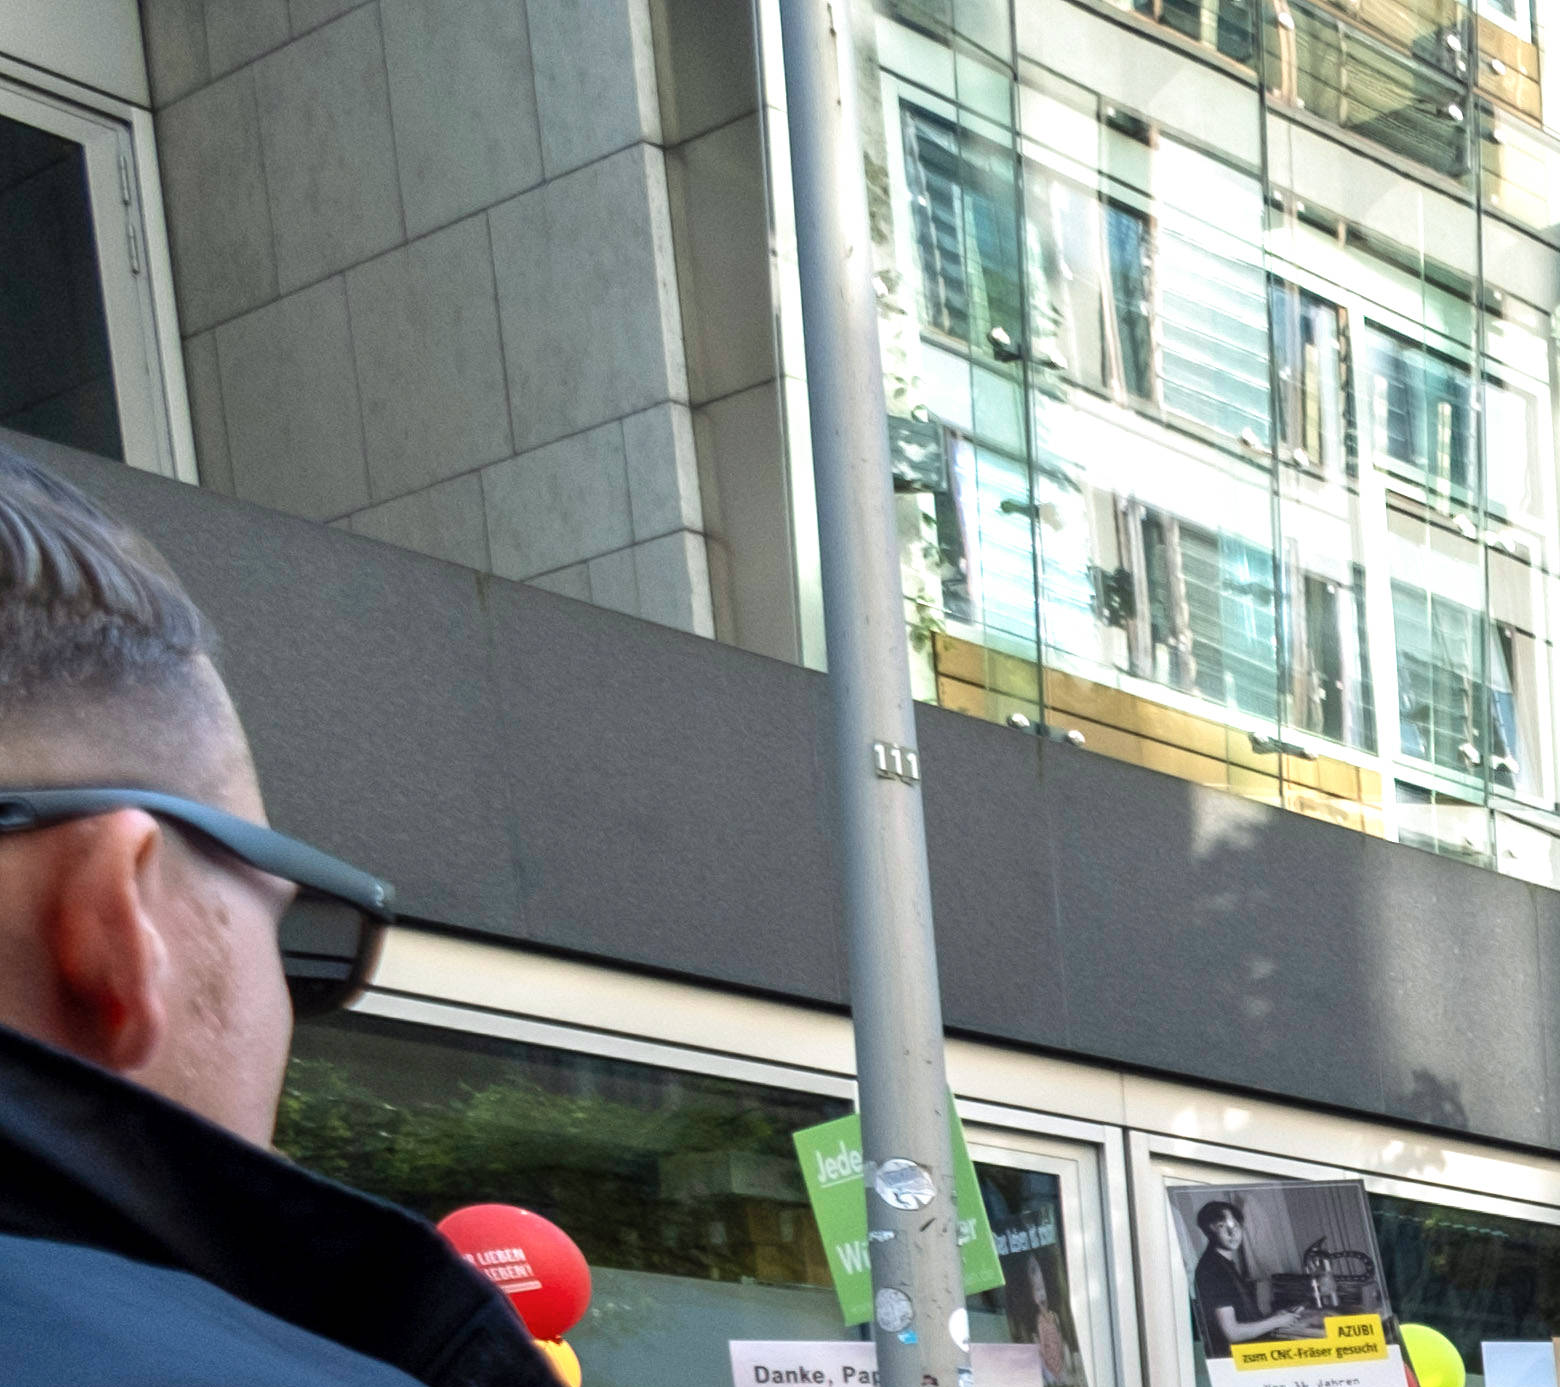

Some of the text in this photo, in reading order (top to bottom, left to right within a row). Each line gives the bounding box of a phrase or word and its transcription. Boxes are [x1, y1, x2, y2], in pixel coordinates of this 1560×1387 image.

[815, 1140, 864, 1183] Jede
[1337, 1324, 1374, 1338] AZUBI
[1243, 1352, 1267, 1364] zum
[1336, 1341, 1378, 1358] gesucht
[753, 1365, 834, 1387] Danke,
